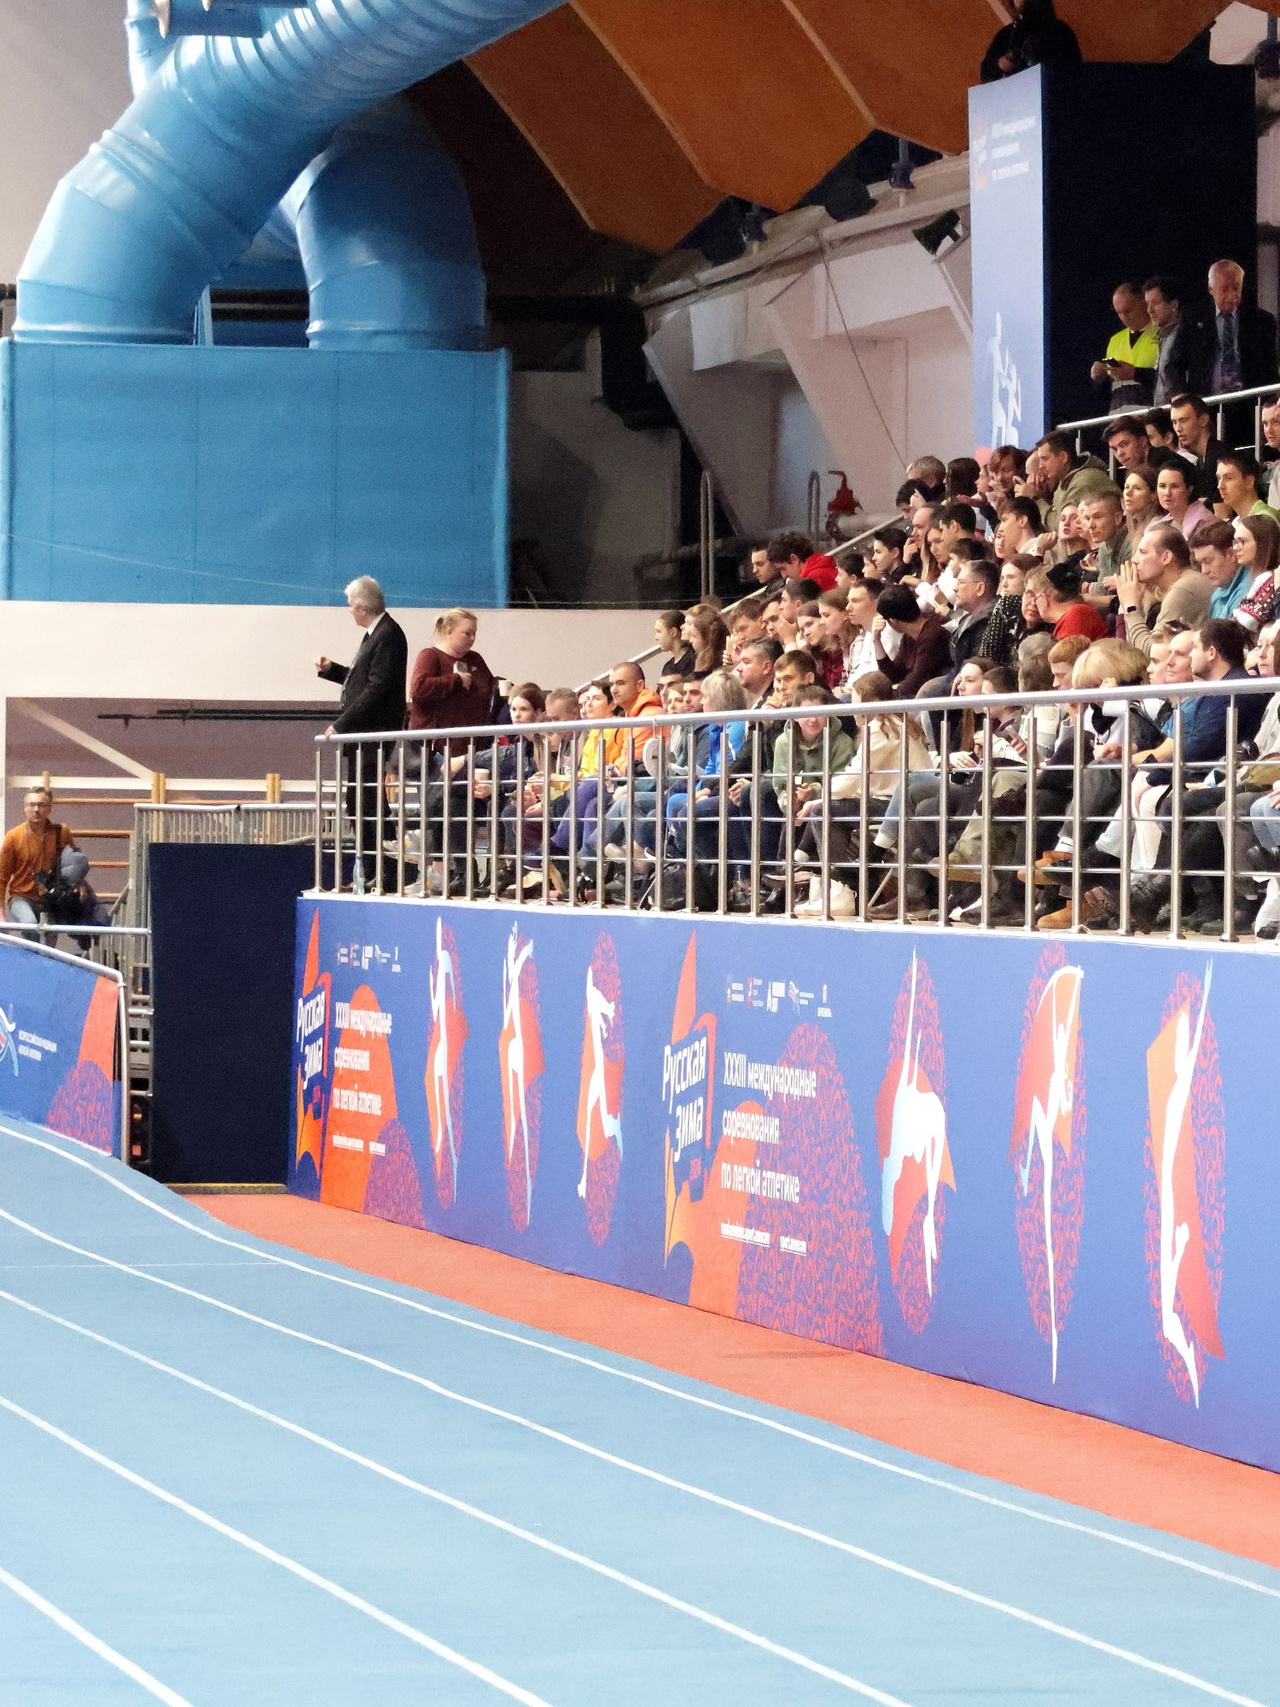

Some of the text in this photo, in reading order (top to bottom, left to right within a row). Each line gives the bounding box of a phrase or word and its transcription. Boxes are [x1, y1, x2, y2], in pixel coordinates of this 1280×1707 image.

[662, 1036, 707, 1115] Русская
[747, 1062, 817, 1103] международные
[674, 1096, 704, 1163] Зима
[722, 1109, 780, 1146] соревнования
[721, 1162, 731, 1189] по
[732, 1159, 761, 1194] легкой
[762, 1168, 800, 1204] атлетике
